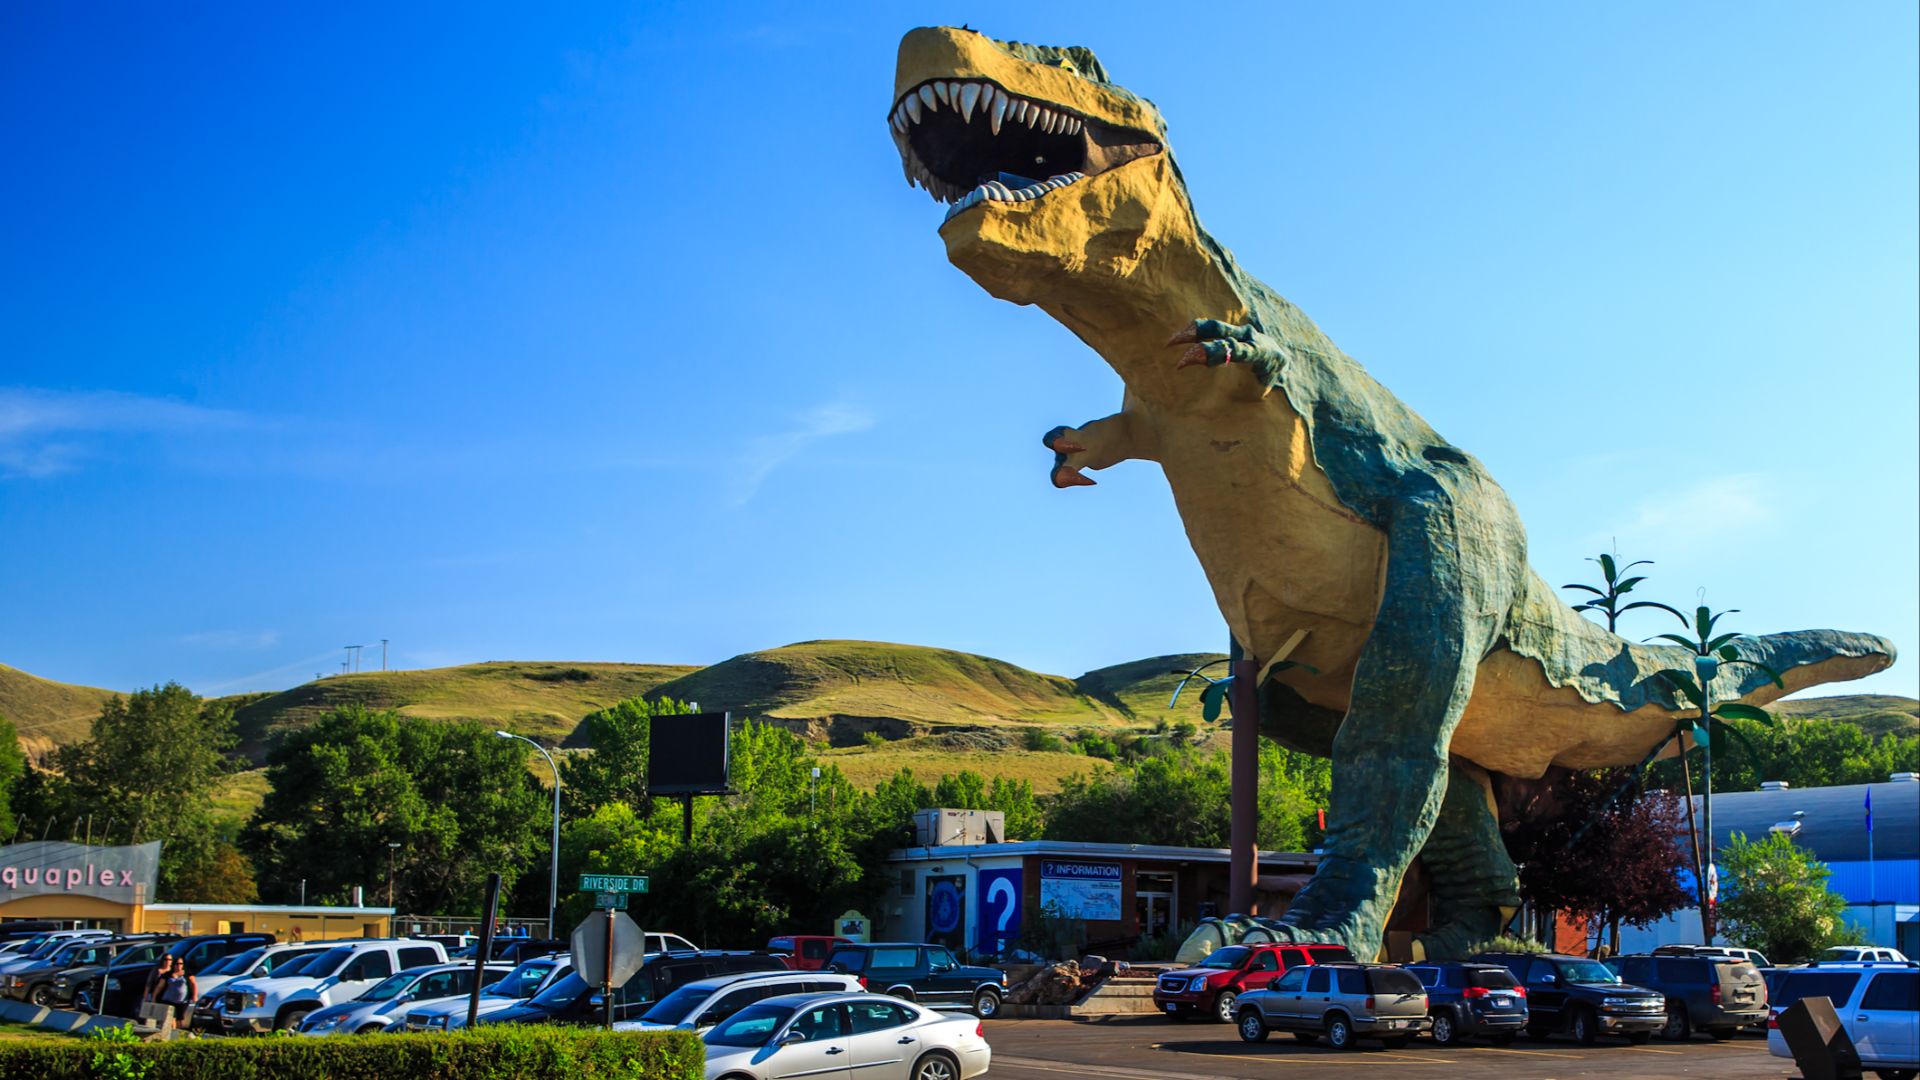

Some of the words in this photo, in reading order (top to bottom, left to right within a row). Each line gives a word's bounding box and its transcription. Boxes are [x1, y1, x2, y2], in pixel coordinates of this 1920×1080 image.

[1056, 864, 1119, 876] INFORMATION
[2, 864, 133, 890] quaplex
[583, 877, 629, 890] RIVERSIDE
[632, 878, 645, 890] DR
